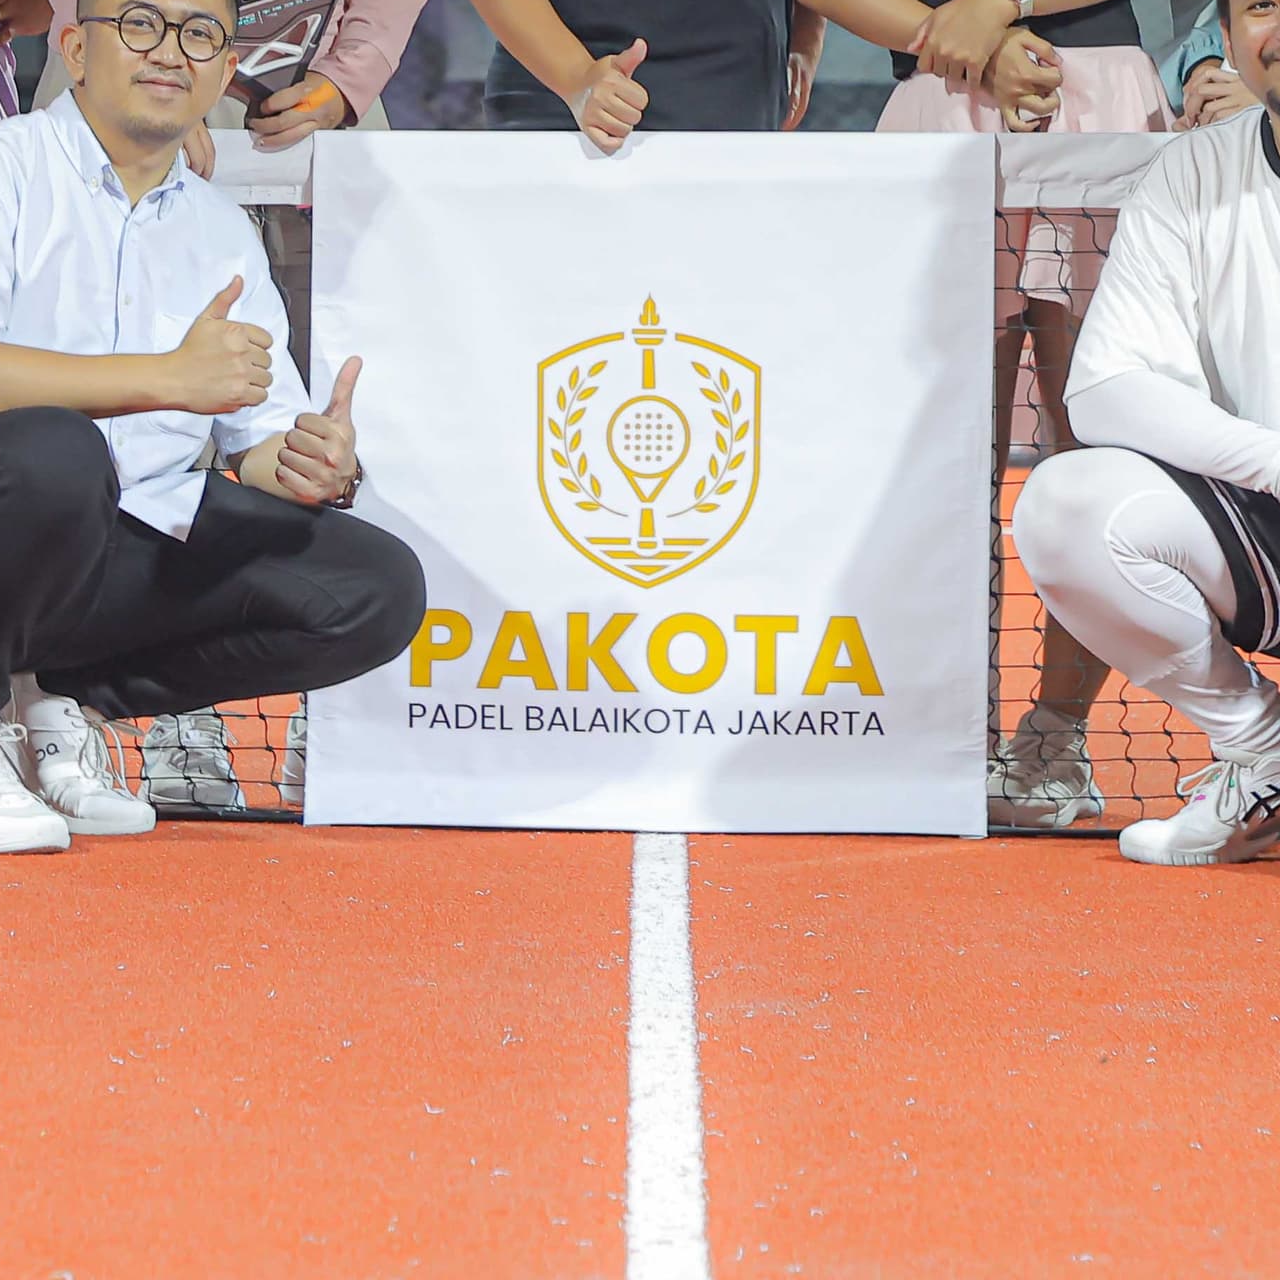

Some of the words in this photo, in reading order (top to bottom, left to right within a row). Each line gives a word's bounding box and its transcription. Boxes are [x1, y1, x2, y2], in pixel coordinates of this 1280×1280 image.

[409, 607, 886, 697] PAKOTA
[408, 703, 514, 732] PADEL
[525, 705, 716, 735] BALAIKOTA
[727, 710, 886, 737] JAKARTA
